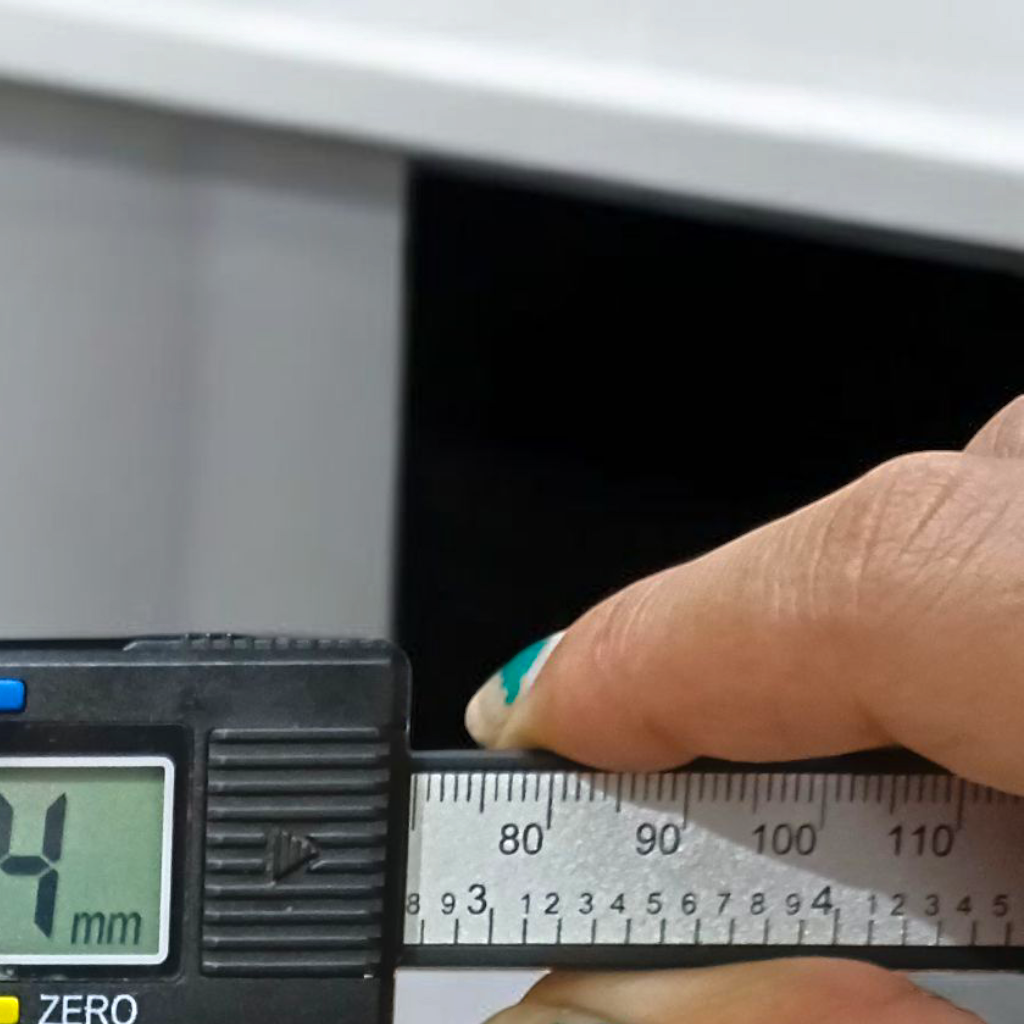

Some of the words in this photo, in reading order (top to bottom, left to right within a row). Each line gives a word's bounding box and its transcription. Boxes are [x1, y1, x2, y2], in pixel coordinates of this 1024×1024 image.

[499, 823, 543, 855] 80
[636, 823, 680, 856] 90
[752, 823, 817, 855] 100
[888, 824, 955, 857] 110
[406, 893, 420, 915] 8
[441, 893, 456, 915] 9
[467, 884, 487, 915] 3
[521, 893, 530, 914] 1
[544, 893, 560, 915] 2
[579, 893, 594, 915] 3
[610, 893, 625, 914] 4
[646, 893, 662, 915] 5
[681, 893, 697, 915] 6
[717, 893, 731, 915] 7
[750, 893, 765, 916] 8
[785, 893, 801, 915] 9
[811, 886, 833, 915] 4
[867, 894, 876, 914] 1
[891, 894, 906, 916] 2
[926, 894, 940, 916] 3
[957, 894, 972, 914] 4
[993, 894, 1009, 916] 5
[71, 910, 142, 945] mm
